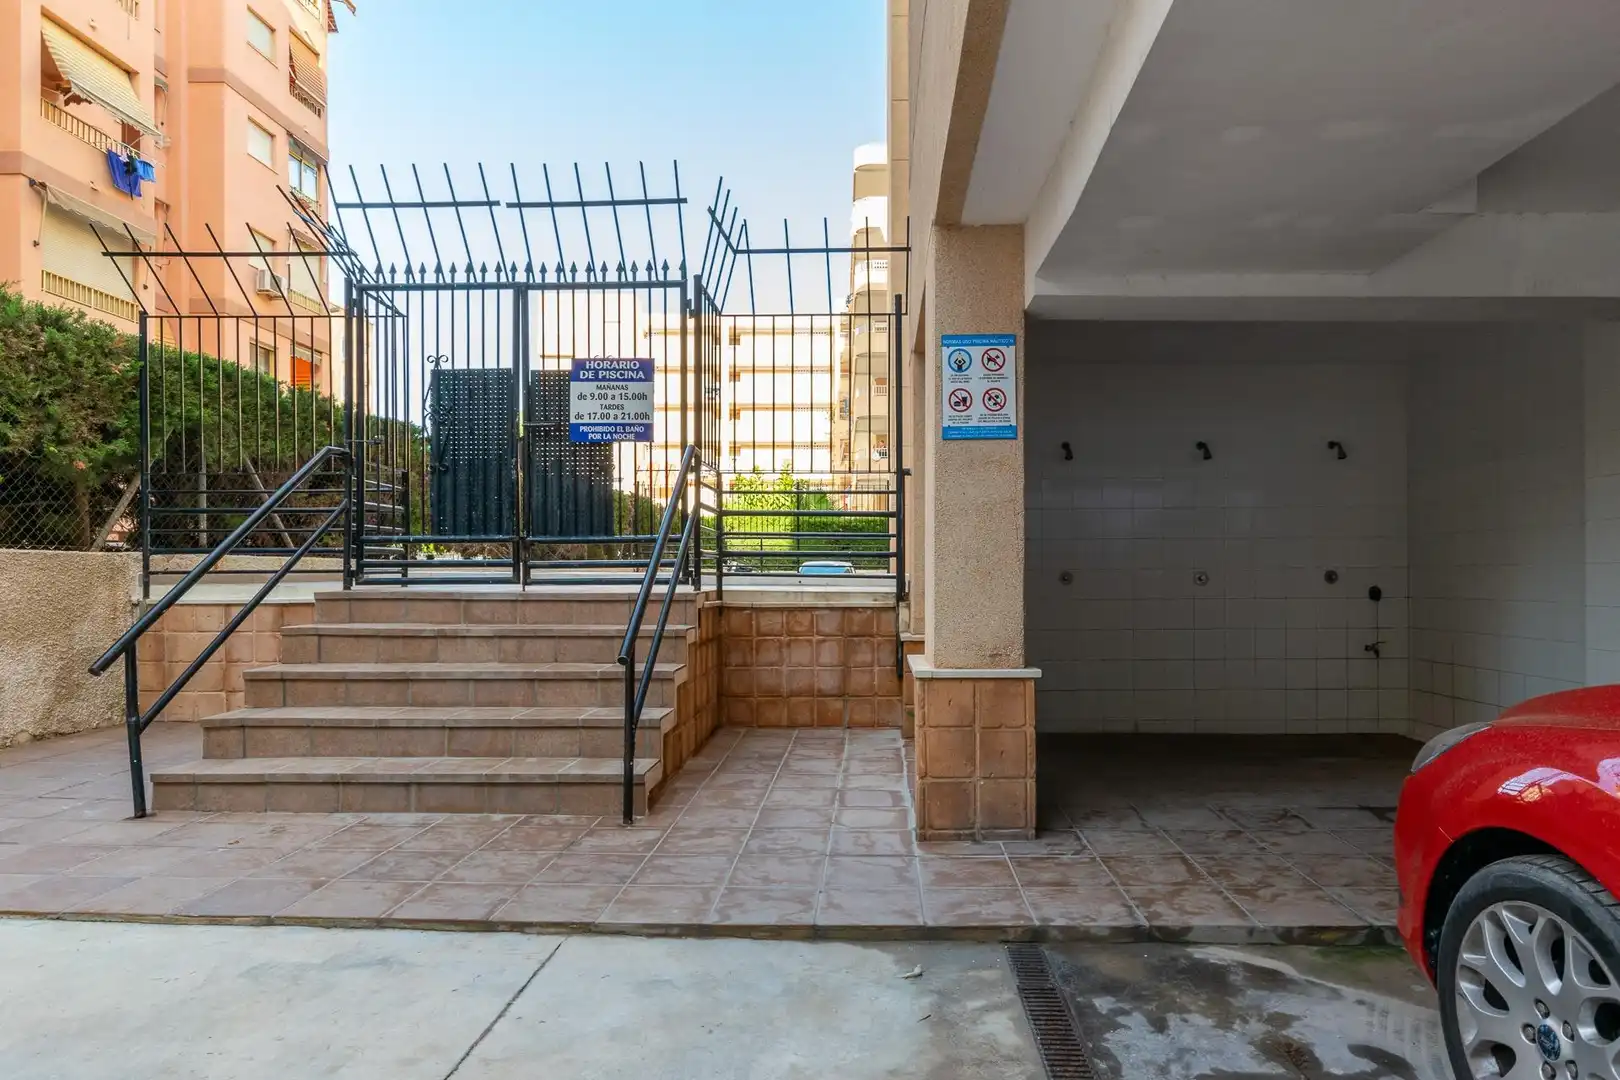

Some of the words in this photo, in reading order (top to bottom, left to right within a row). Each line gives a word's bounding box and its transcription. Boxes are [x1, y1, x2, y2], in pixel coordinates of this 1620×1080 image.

[585, 360, 640, 369] HORARIO
[579, 370, 595, 379] DE
[598, 370, 645, 379] PISCINA
[596, 383, 629, 391] MAÑANAS
[577, 392, 588, 400] de
[589, 392, 608, 400] 9.00
[619, 392, 648, 400] 15.00h
[574, 412, 585, 420] de
[587, 412, 611, 420] 17.00
[620, 412, 650, 420] 21.00h
[579, 425, 615, 433] PROHIBIDO
[616, 425, 625, 433] EL
[625, 424, 645, 433] BAÑO
